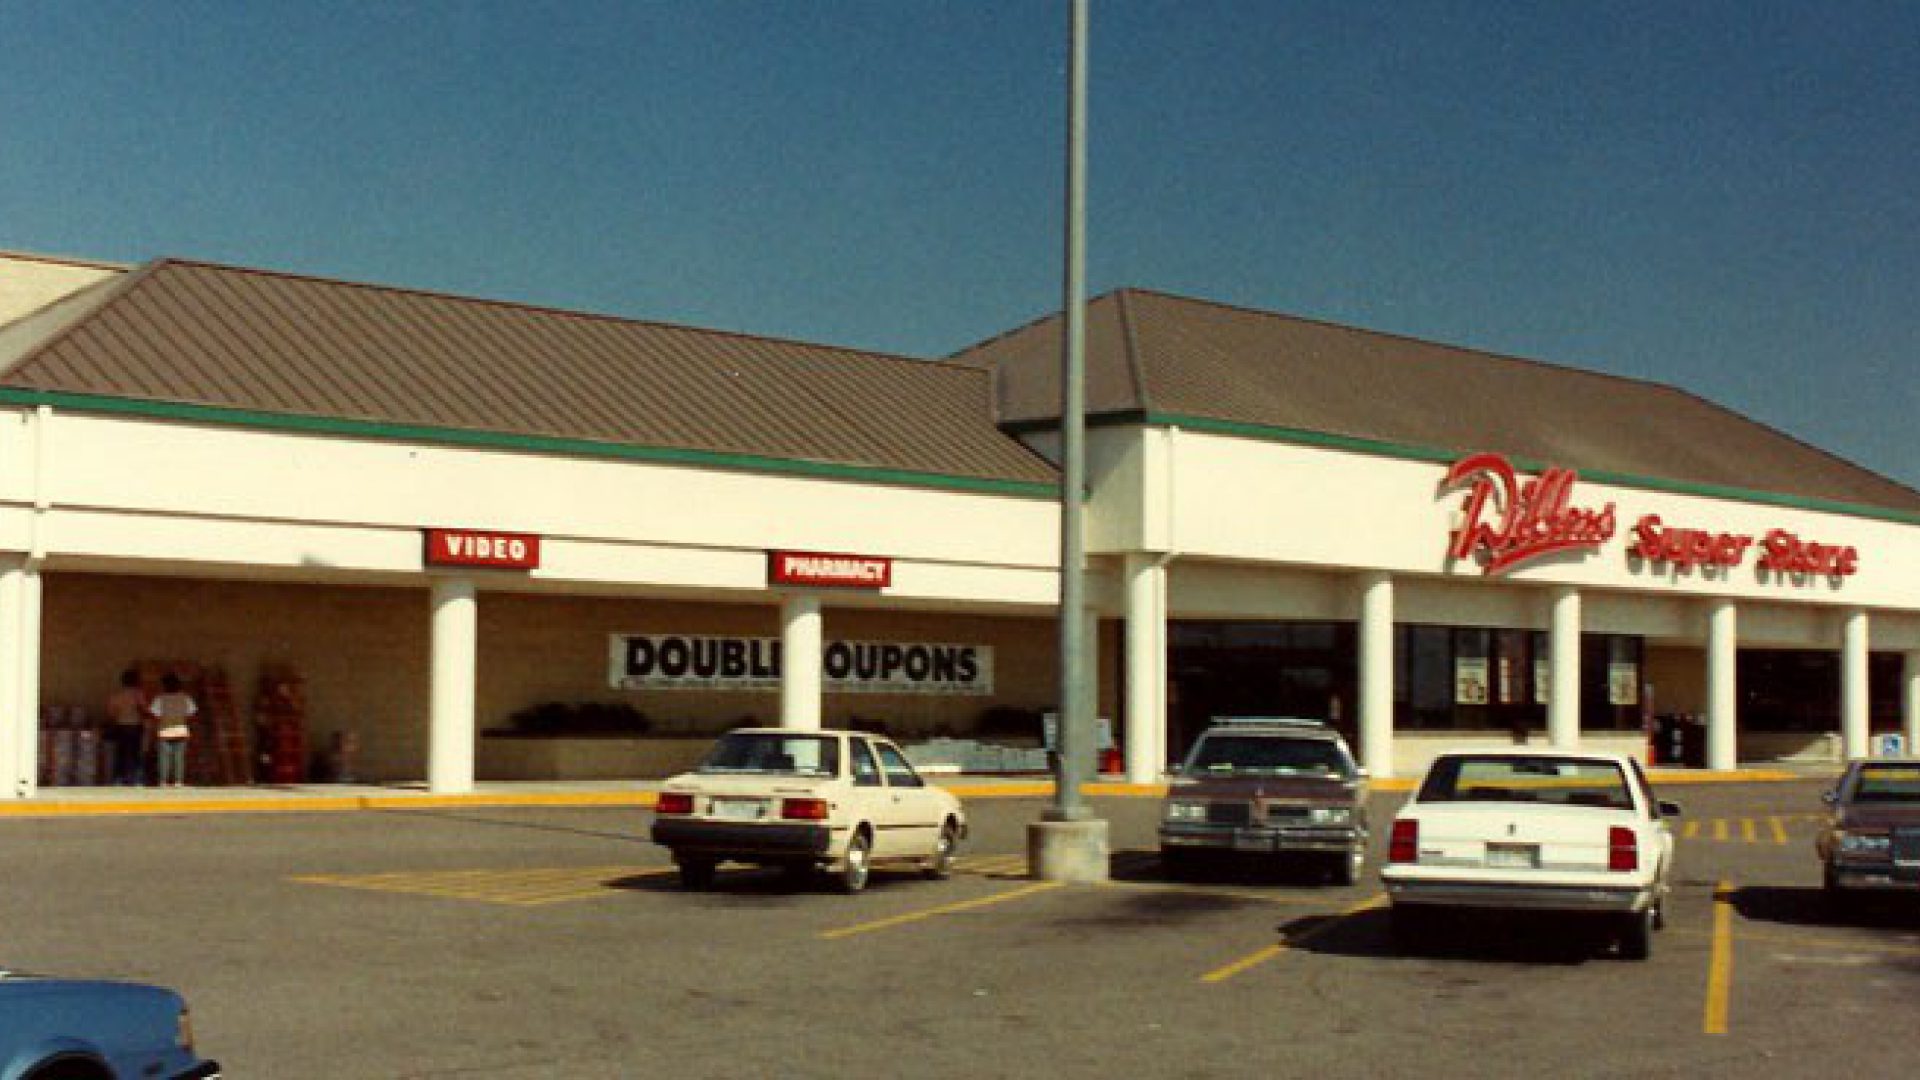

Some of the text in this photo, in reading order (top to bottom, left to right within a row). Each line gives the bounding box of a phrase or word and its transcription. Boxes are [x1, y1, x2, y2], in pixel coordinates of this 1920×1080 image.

[445, 535, 527, 561] VIDEO
[784, 557, 886, 581] PHARMACY
[824, 641, 977, 682] OUPONS
